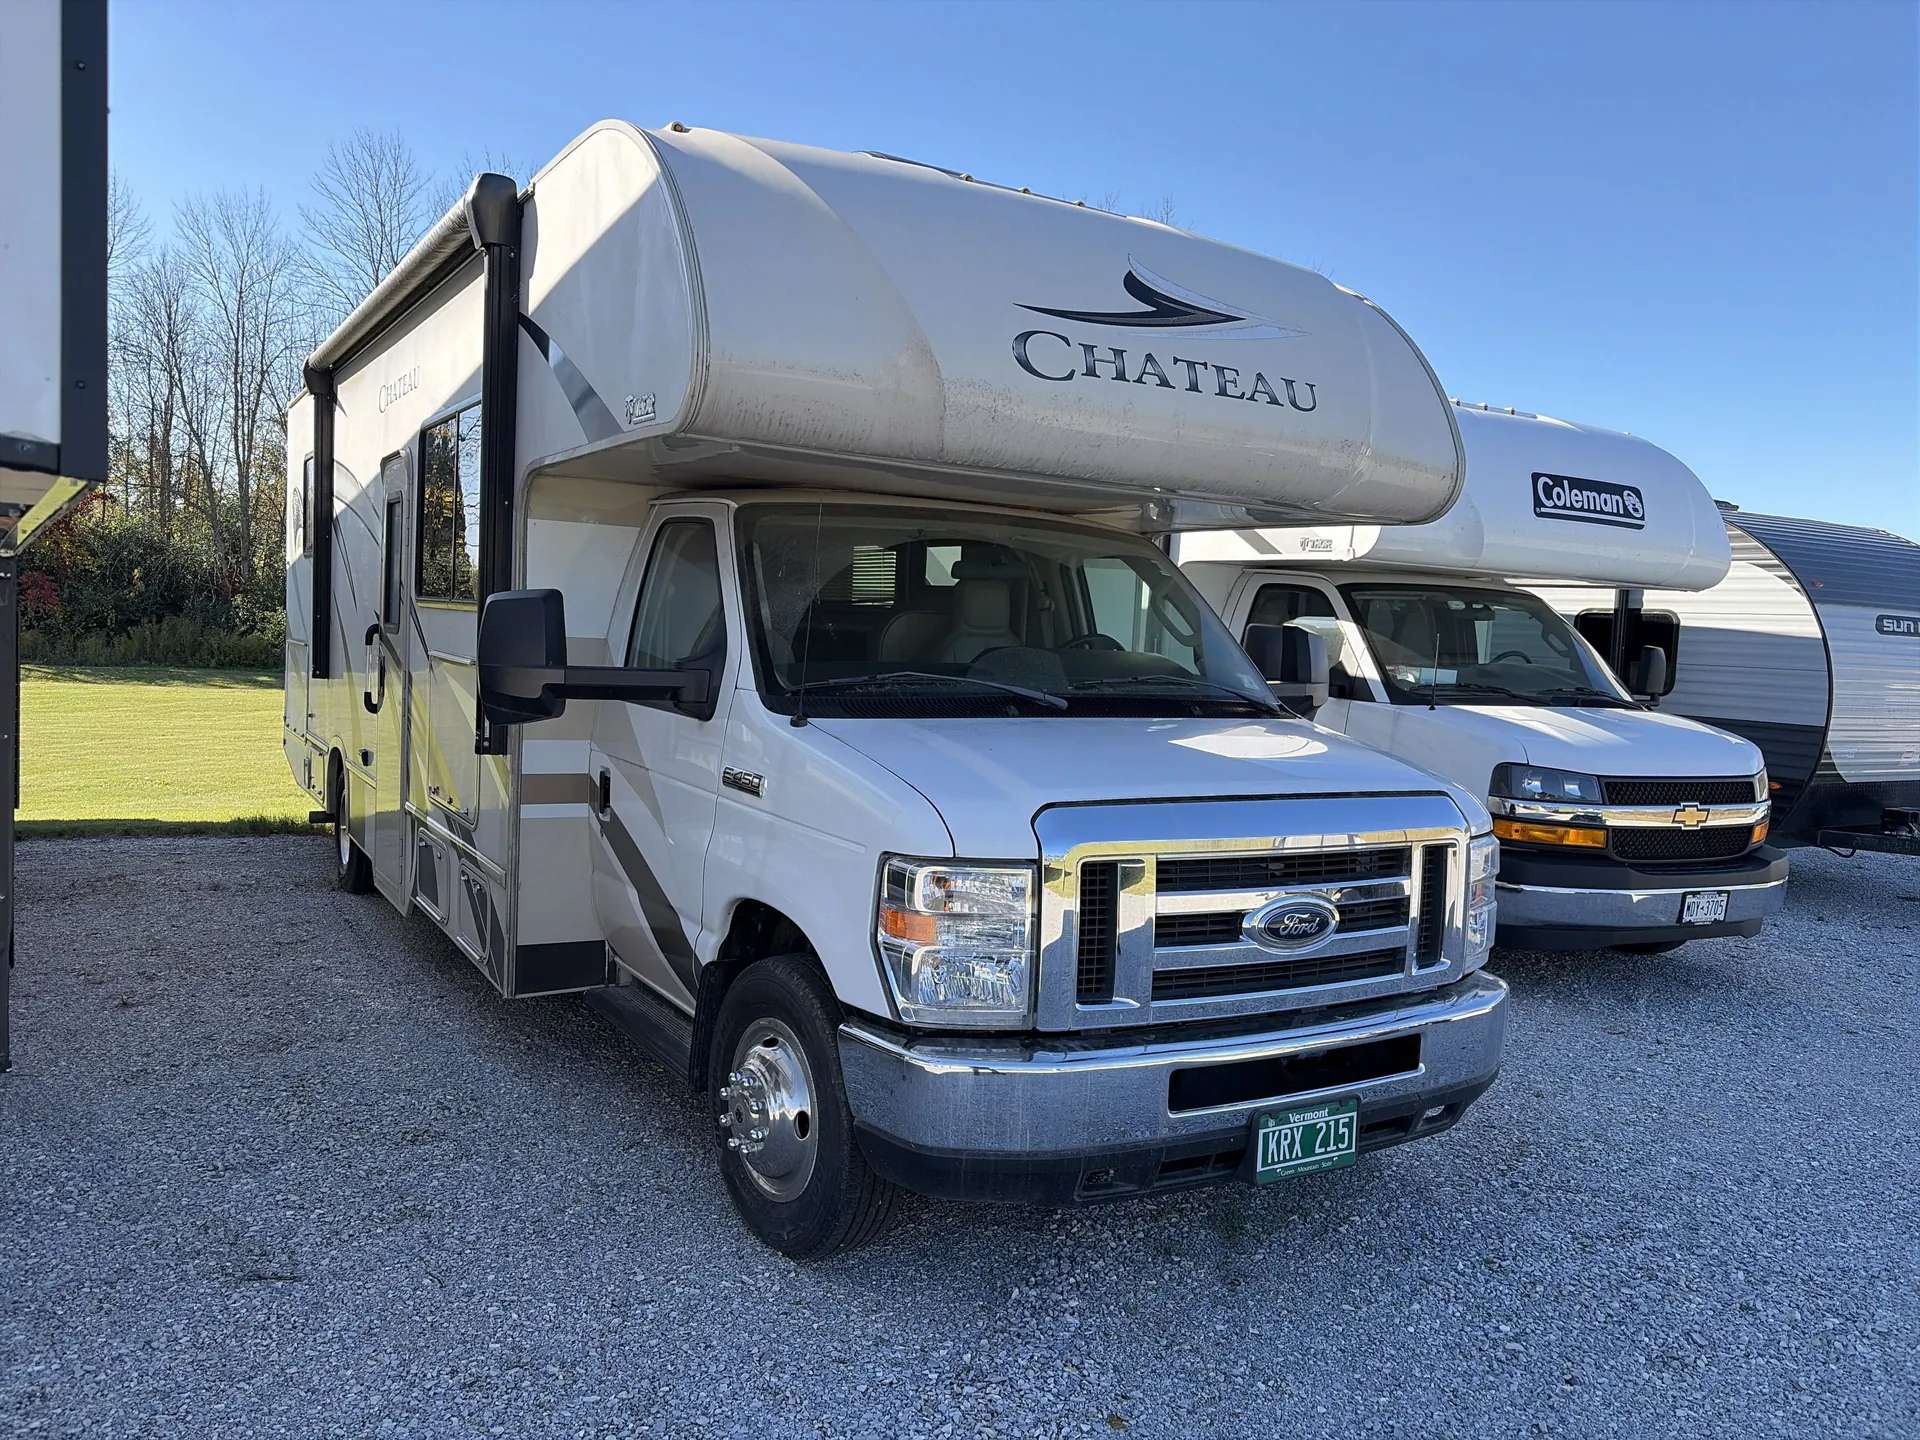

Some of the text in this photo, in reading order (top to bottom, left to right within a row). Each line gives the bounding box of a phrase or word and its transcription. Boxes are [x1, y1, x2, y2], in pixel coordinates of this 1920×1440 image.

[378, 365, 420, 413] CHATEAU
[1011, 330, 1318, 413] CHATEAU
[1537, 476, 1624, 514] Coleman
[1279, 913, 1320, 936] Ford
[1288, 1107, 1329, 1123] Vermont
[1267, 1117, 1350, 1163] KRX 215
